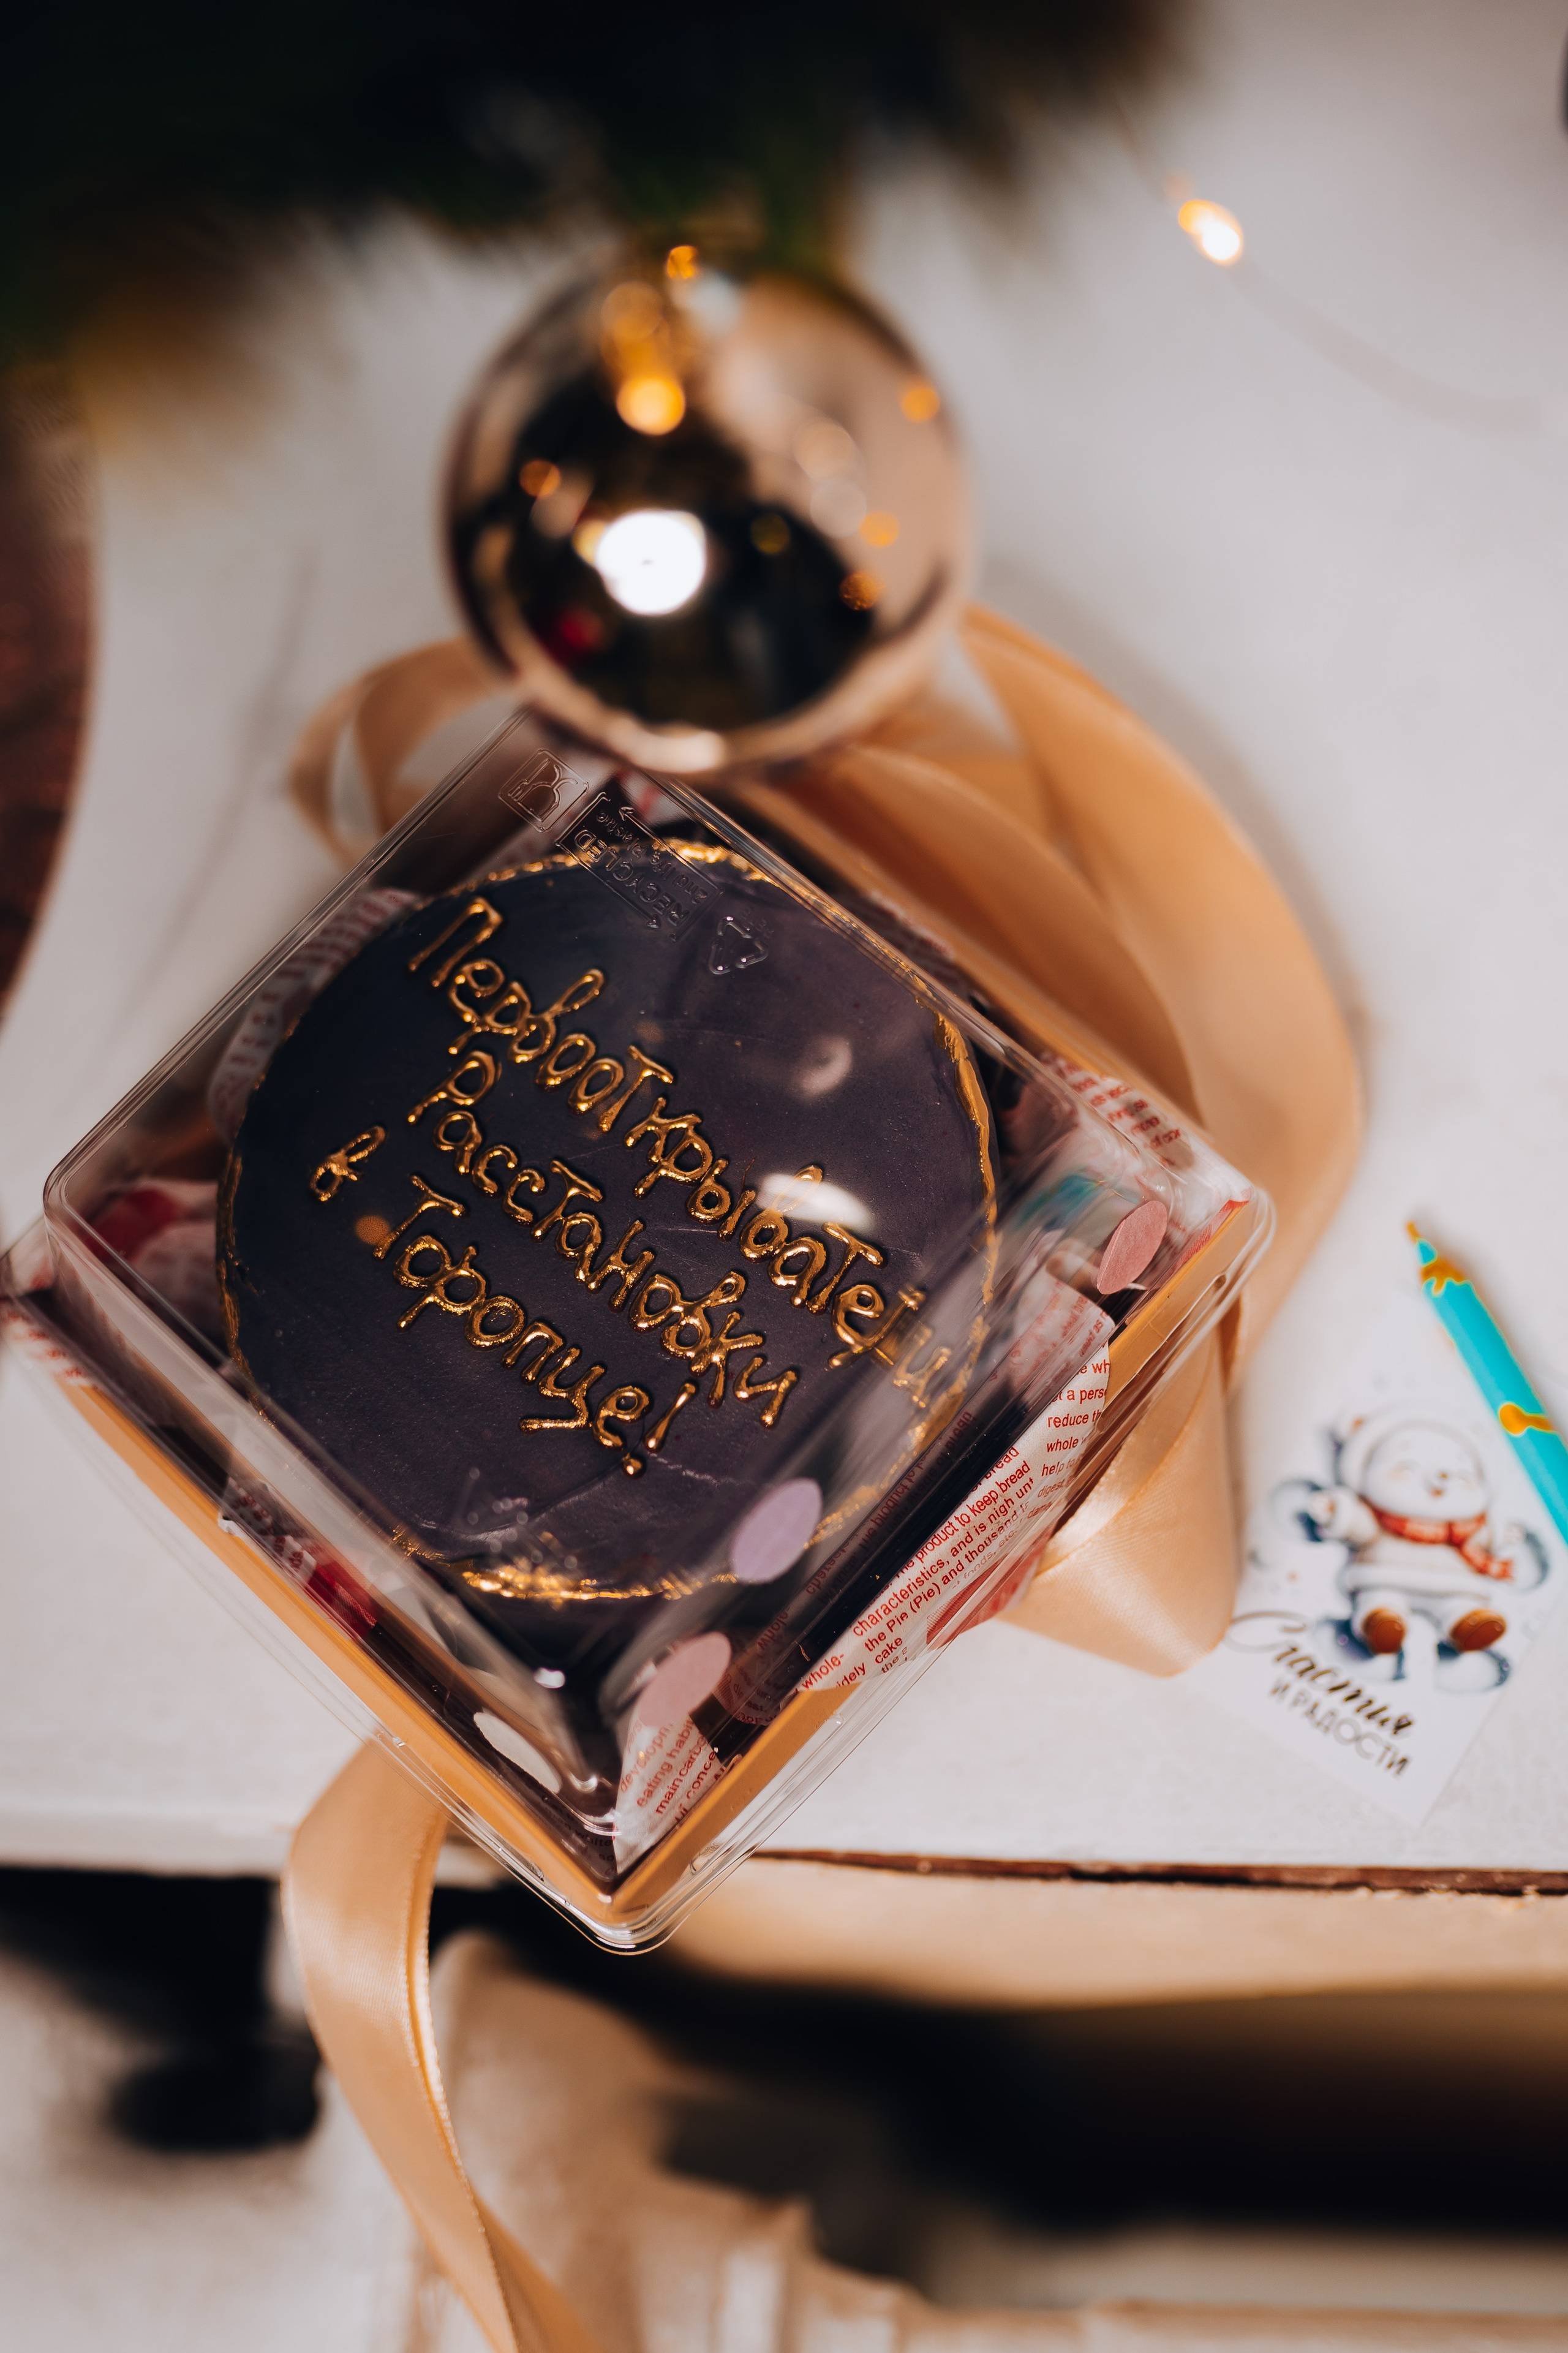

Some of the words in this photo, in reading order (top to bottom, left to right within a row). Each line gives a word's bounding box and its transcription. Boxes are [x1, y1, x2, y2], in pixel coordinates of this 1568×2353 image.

[574, 829, 690, 927] RECYCLED
[1067, 1390, 1075, 1400] a
[1047, 1413, 1089, 1428] reduce
[1047, 1437, 1079, 1452] whole
[1041, 1463, 1065, 1476] help
[915, 1521, 959, 1562] product
[956, 1511, 971, 1527] to
[968, 1488, 999, 1519] keep
[1000, 1460, 1031, 1495] bread
[853, 1558, 950, 1637] characteristics,
[950, 1532, 974, 1557] and
[974, 1522, 987, 1536] is
[864, 1630, 886, 1652] the
[886, 1611, 910, 1633] Pie
[909, 1582, 941, 1614] (Pie)
[941, 1562, 965, 1585] and
[965, 1511, 1019, 1562] thousand
[875, 1636, 903, 1664] cake
[802, 1653, 845, 1691] whole-
[636, 1761, 673, 1807] eating
[656, 1778, 683, 1815] main
